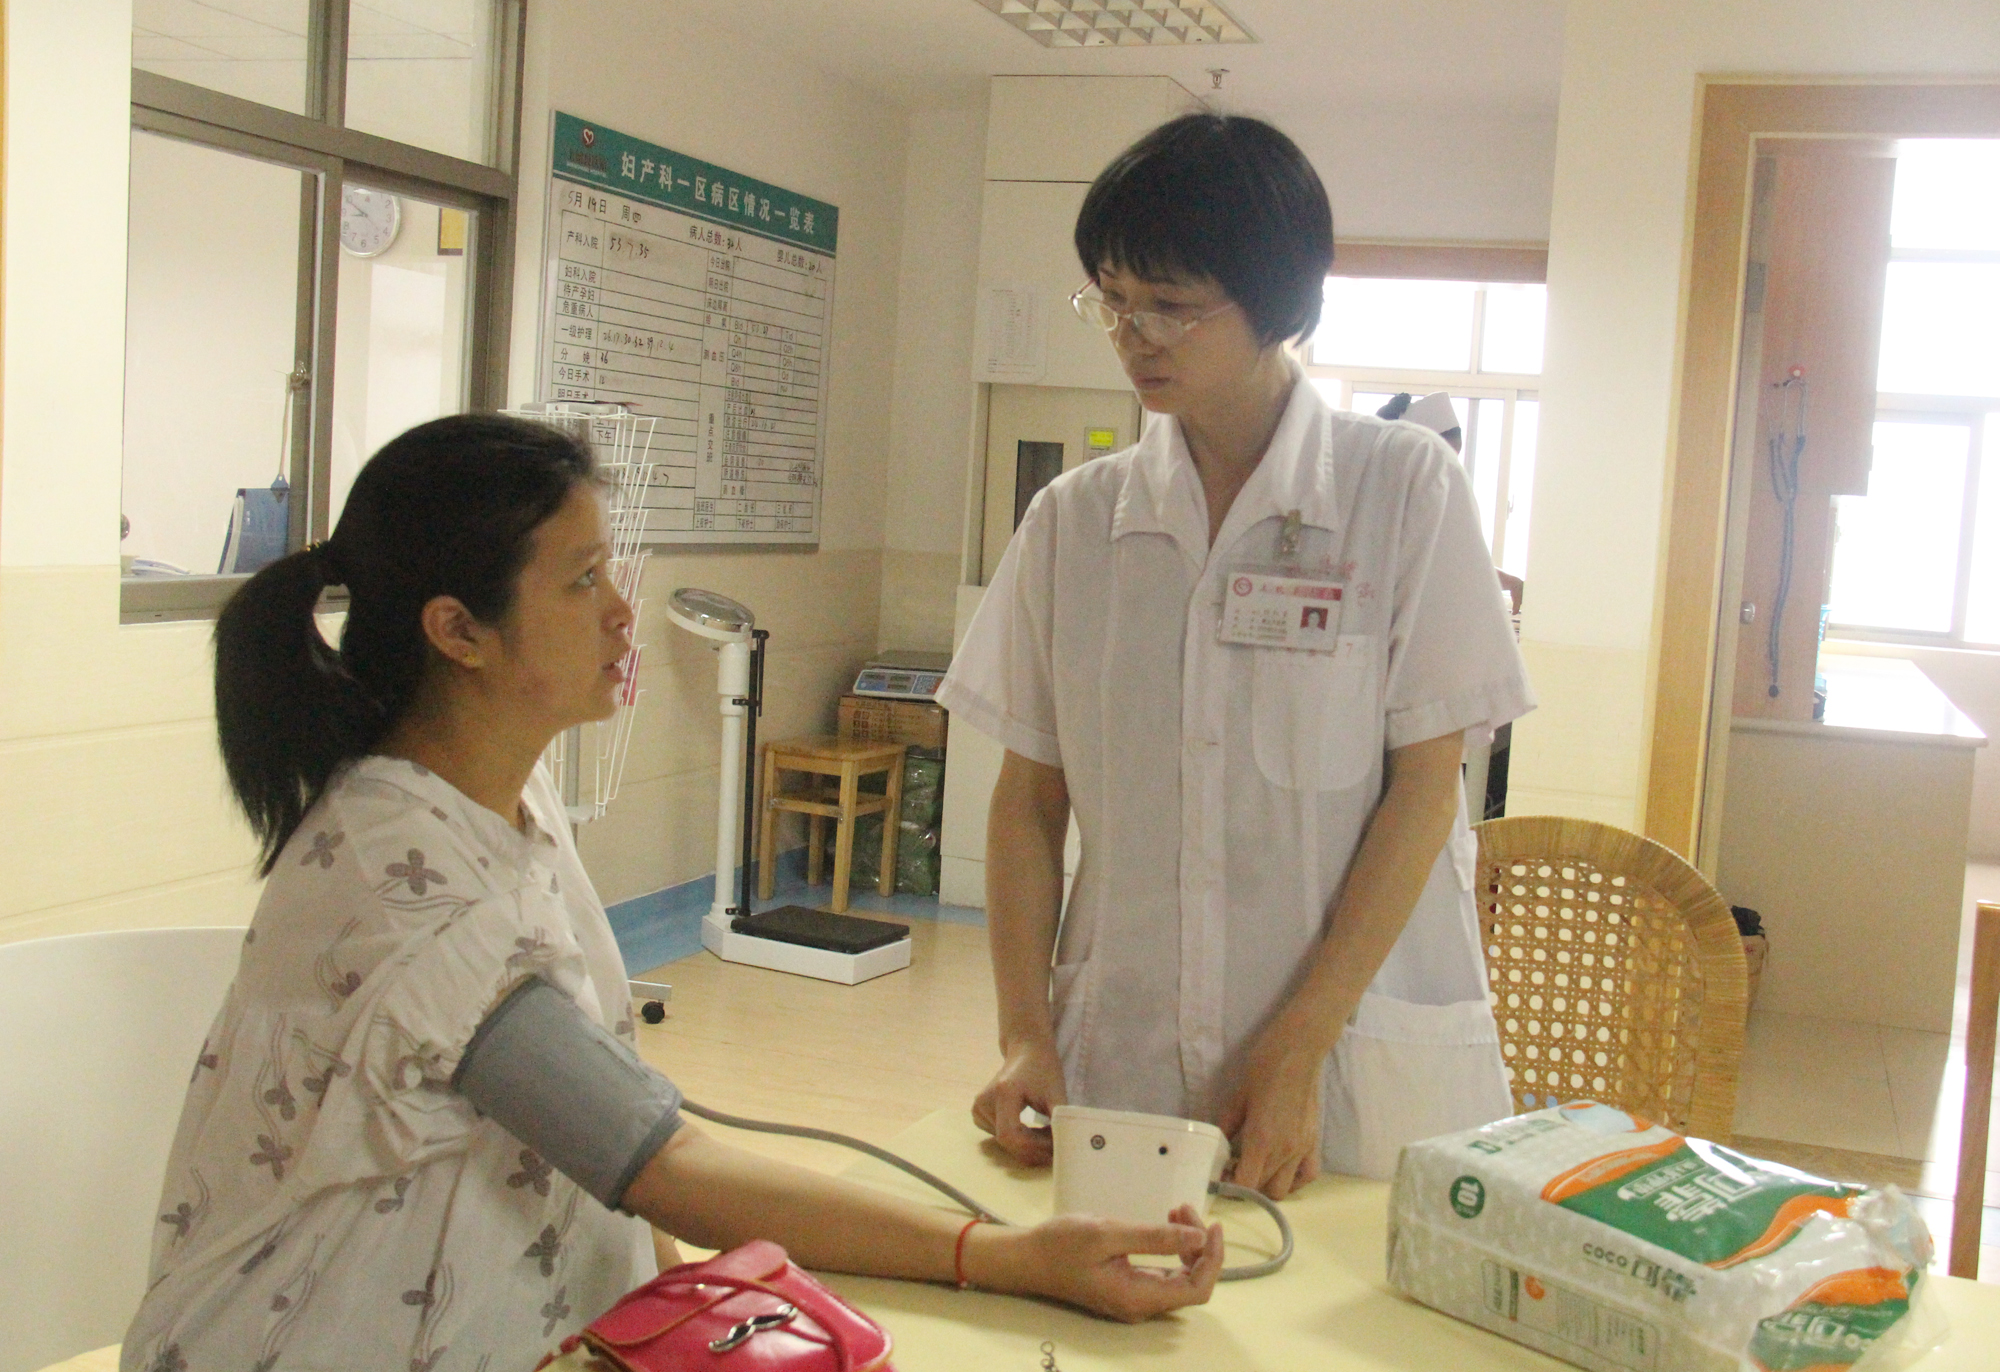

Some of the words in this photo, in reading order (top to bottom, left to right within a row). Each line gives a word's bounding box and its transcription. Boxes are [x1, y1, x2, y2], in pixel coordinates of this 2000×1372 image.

[620, 150, 815, 235] 妇产科一区病区情况一览表
[566, 230, 599, 250] 产科入院
[564, 264, 597, 284] 妇科入院
[563, 283, 595, 302] 待产孕妇
[562, 300, 594, 318] 危重病人
[561, 324, 593, 341] 一级护理
[558, 366, 591, 383] 今日手术
[596, 429, 612, 443] 下午
